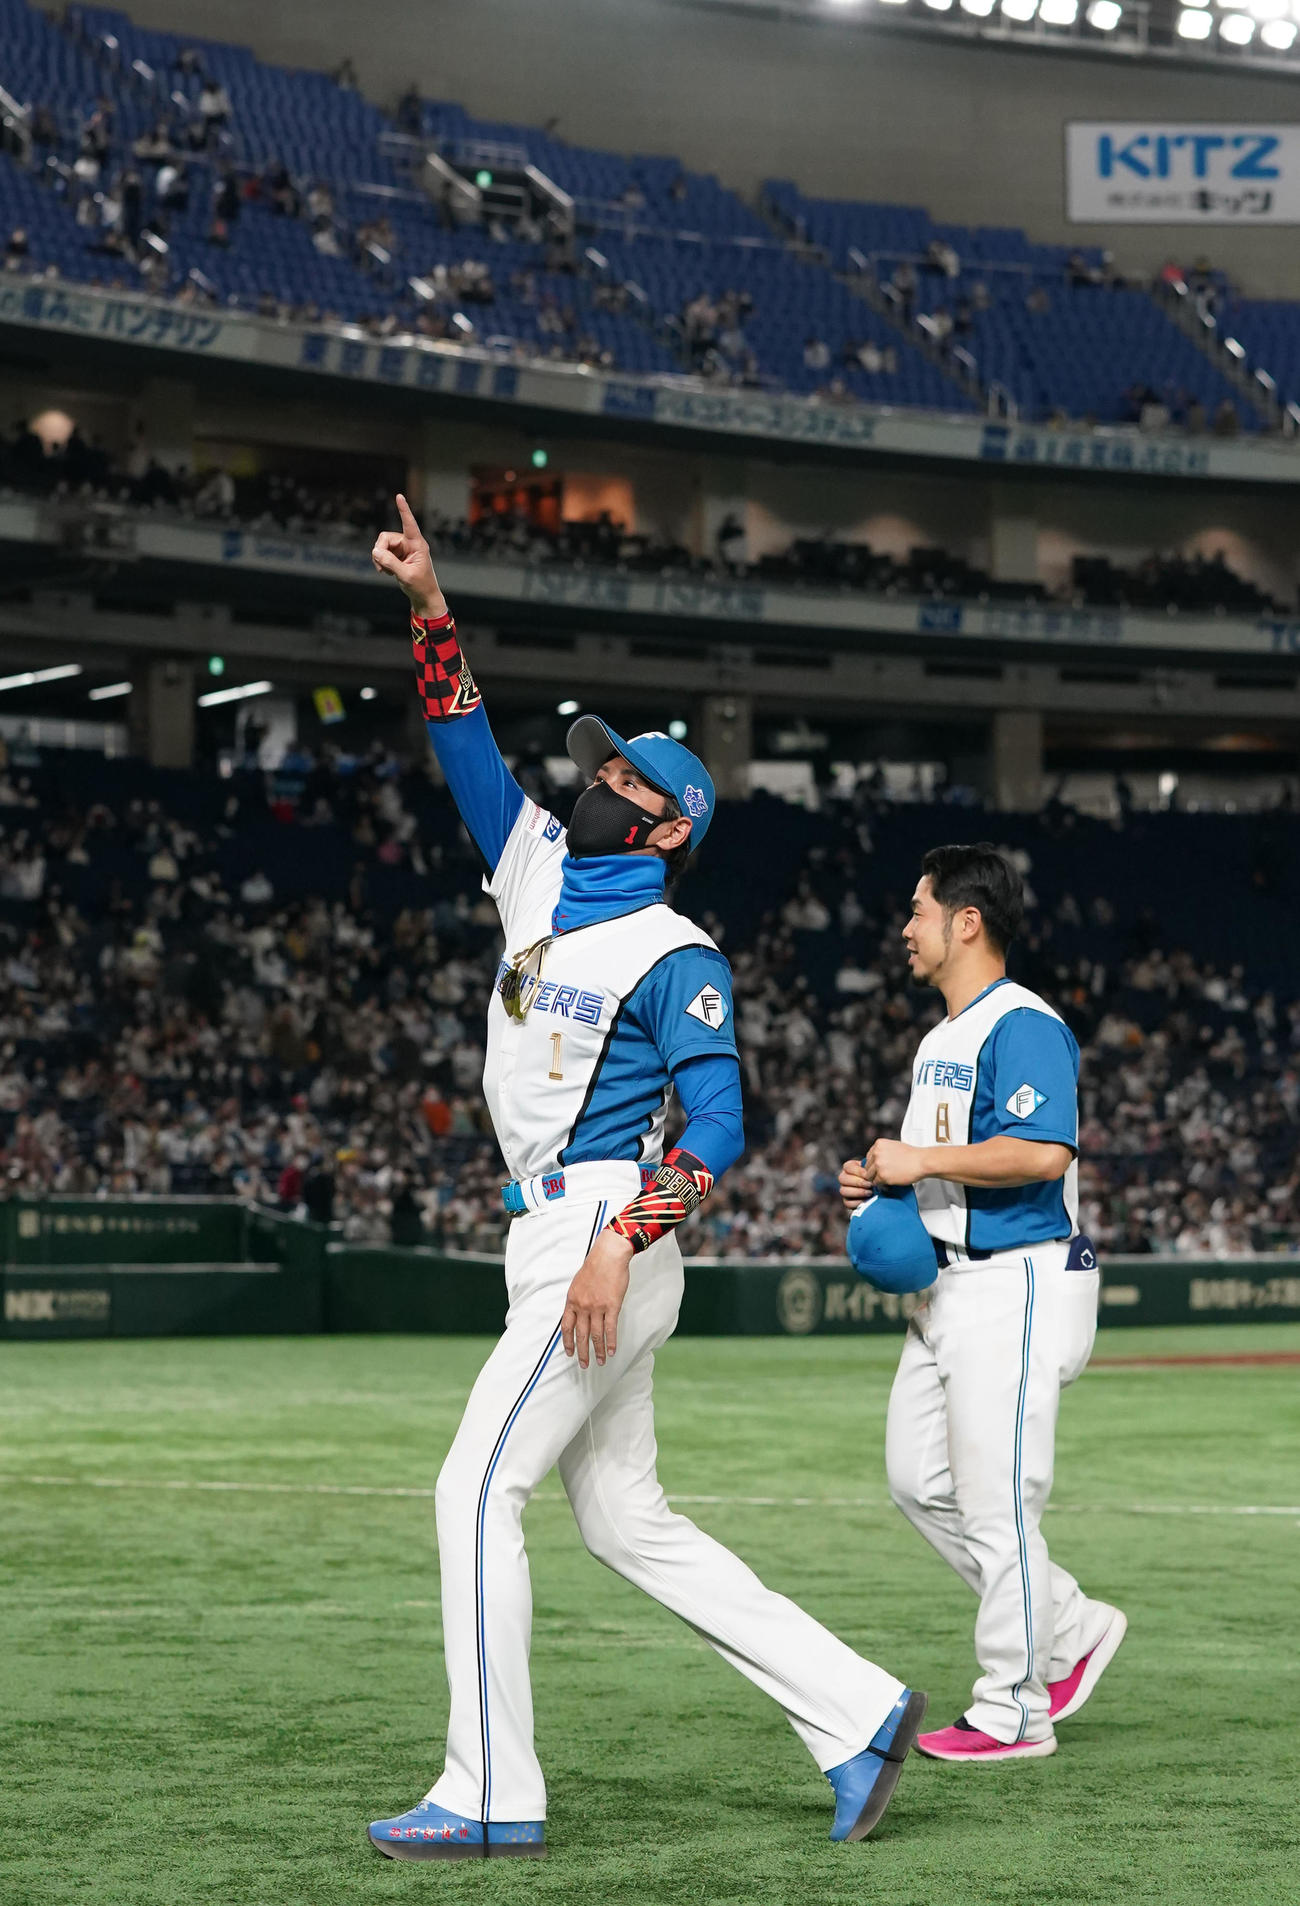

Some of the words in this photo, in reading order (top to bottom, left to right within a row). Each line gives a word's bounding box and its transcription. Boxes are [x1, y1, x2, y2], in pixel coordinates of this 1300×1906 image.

[1098, 135, 1280, 179] KITZ
[624, 826, 639, 844] 1
[548, 1032, 563, 1081] 1
[936, 1103, 951, 1143] 8
